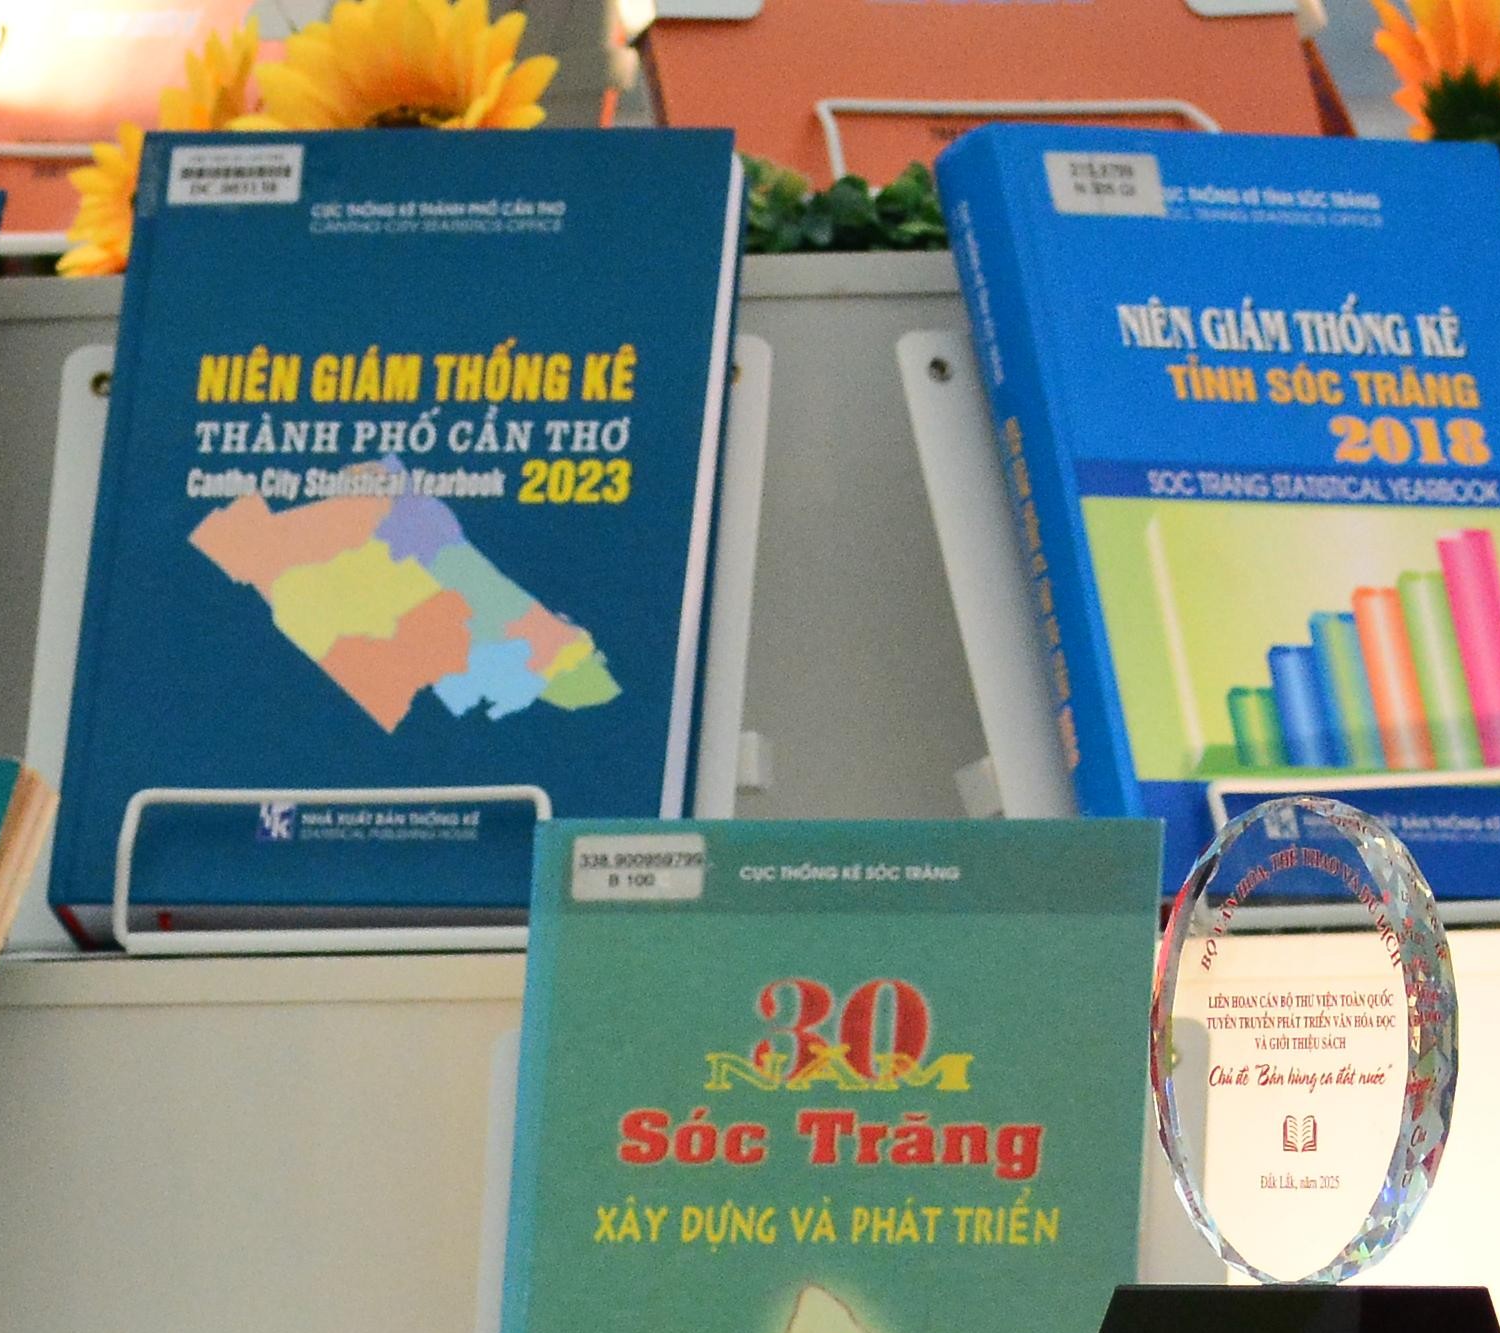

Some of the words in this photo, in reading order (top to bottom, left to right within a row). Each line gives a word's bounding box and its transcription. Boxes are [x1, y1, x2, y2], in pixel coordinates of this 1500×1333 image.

[1117, 295, 1197, 349] NIÊN
[1200, 295, 1291, 352] GIÁM
[1293, 292, 1411, 356] THỐNG
[1416, 305, 1466, 357] KÊ
[197, 344, 301, 402] NIÊN
[311, 345, 422, 402] GIÁM
[433, 337, 572, 402] THỐNG
[581, 343, 636, 402] KÊ
[1165, 353, 1258, 402] TỈNH
[1266, 362, 1345, 405] SÓC
[1350, 366, 1481, 409] TRĂNG
[196, 413, 341, 453] THÀNH
[353, 406, 440, 453] PHỐ
[448, 404, 533, 453] CẦN
[544, 417, 631, 453] THƠ
[1329, 414, 1490, 467] 2018
[261, 468, 300, 501] City
[411, 468, 505, 498] Yearbook
[517, 459, 631, 504] 2023
[1148, 469, 1197, 496] SOC
[1199, 471, 1271, 498] TRANG
[740, 865, 776, 883] CỤC
[864, 863, 902, 881] SÓC
[1206, 1013, 1237, 1030] TUYÊN
[1239, 1011, 1276, 1029] TRUYỀN
[1277, 1012, 1301, 1029] PHÁT
[1303, 1009, 1331, 1029] TRIỂN
[1333, 1012, 1354, 1028] VĂN
[1354, 1012, 1374, 1028] HÓA
[1376, 1015, 1397, 1031] ĐỌC
[1208, 993, 1230, 1009] LIÊN
[1231, 994, 1258, 1008] HOAN
[1259, 992, 1279, 1008] CÁN
[1280, 991, 1294, 1010] BỘ
[1295, 993, 1317, 1008] THƯ
[1316, 991, 1339, 1010] VIỆN
[1340, 990, 1366, 1007] TOÀN
[1367, 988, 1394, 1009] QUỐC
[751, 977, 930, 1082] 30
[1254, 1034, 1267, 1050] VÀ
[1269, 1033, 1290, 1050] GIỚI
[1293, 1033, 1320, 1053] THIỆU
[1321, 1033, 1346, 1049] SÁCH
[704, 1044, 975, 1092] NĂM
[1209, 1065, 1233, 1087] Chủ
[1235, 1065, 1250, 1085] đề
[1287, 1066, 1317, 1094] hùng
[1319, 1073, 1333, 1085] ca
[1335, 1063, 1357, 1085] đất
[619, 1106, 769, 1164] Sóc
[796, 1109, 1044, 1181] Trăng
[594, 1196, 668, 1243] XÂY
[681, 1199, 776, 1252] DỰNG
[791, 1196, 837, 1243] VÀ
[851, 1197, 941, 1243] PHÁT
[953, 1187, 1060, 1244] TRIỂN
